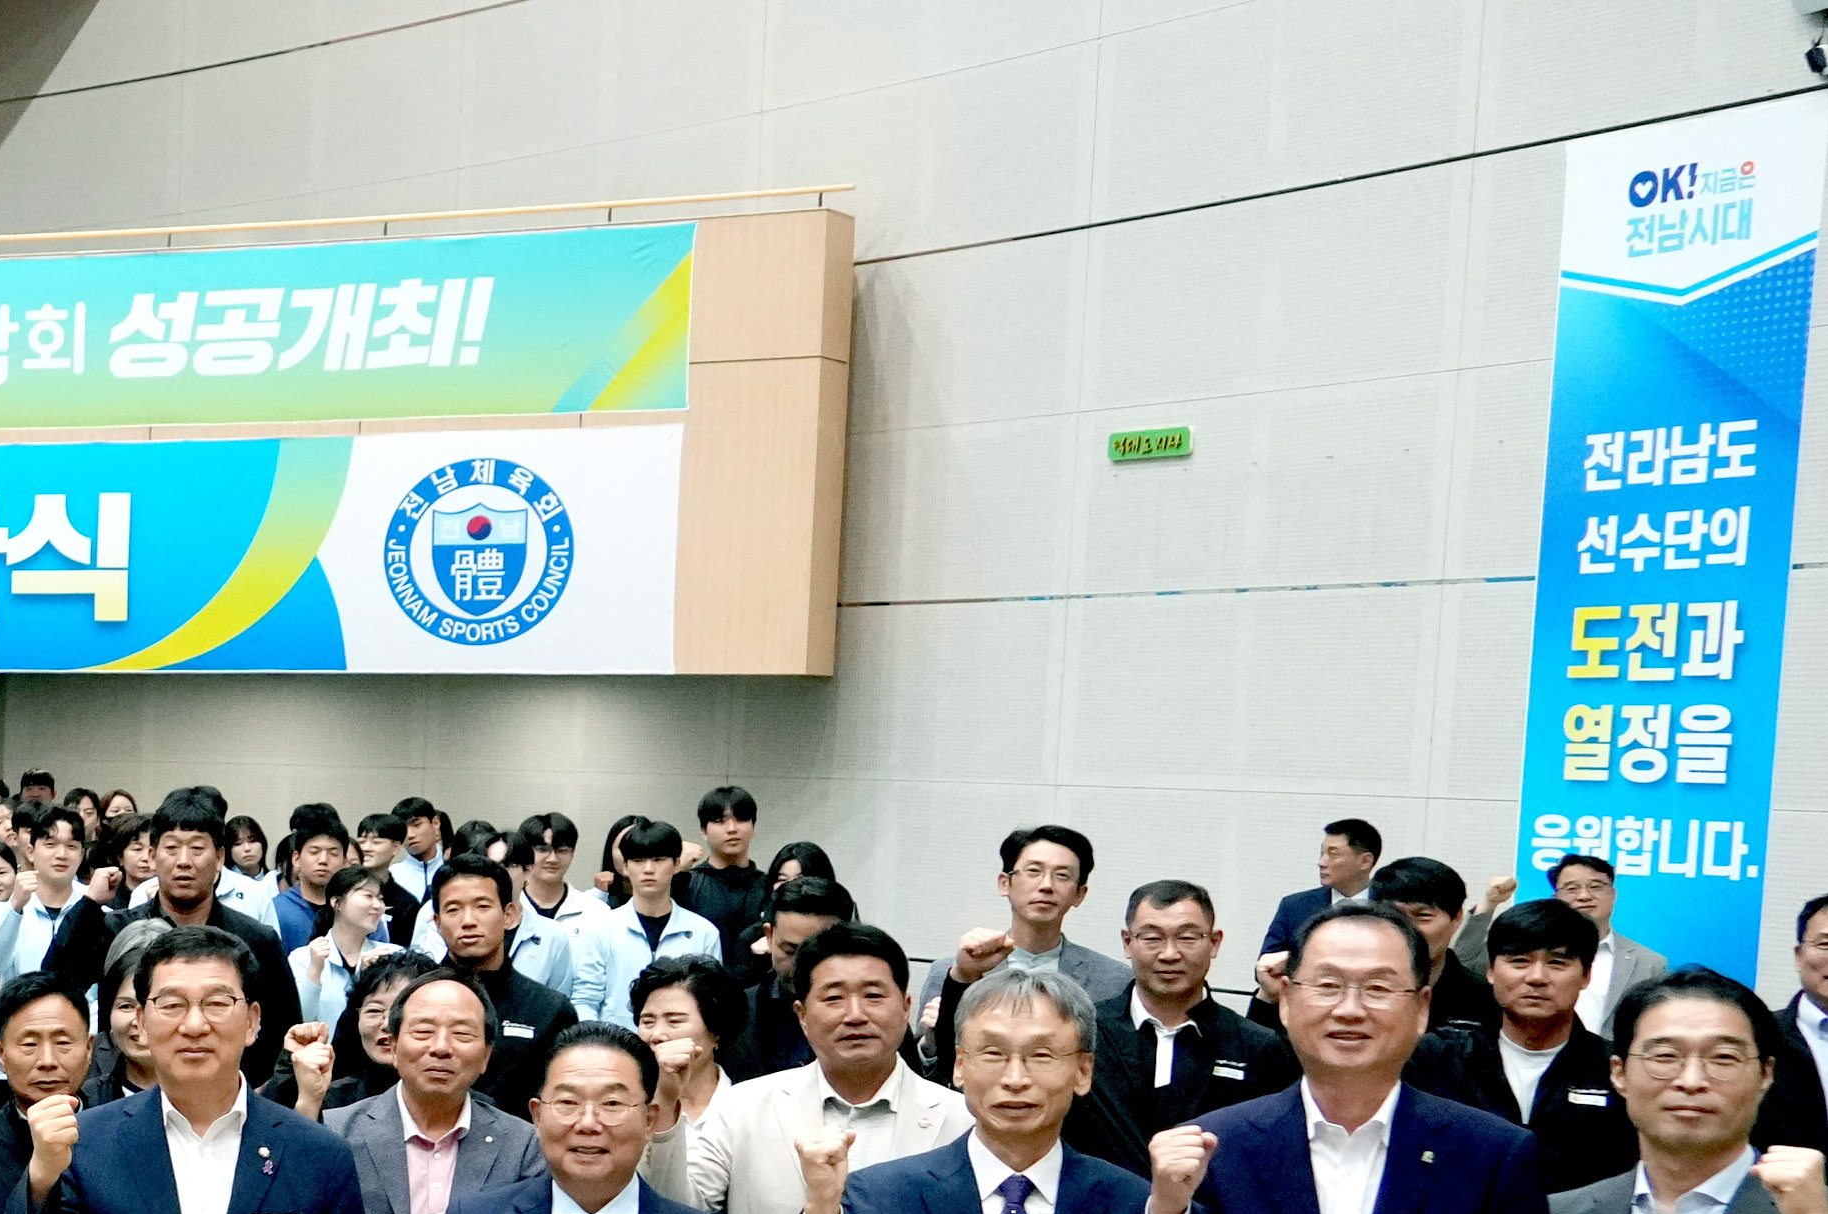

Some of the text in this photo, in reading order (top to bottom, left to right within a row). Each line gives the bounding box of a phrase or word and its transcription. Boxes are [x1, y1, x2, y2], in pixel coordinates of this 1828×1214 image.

[1628, 161, 1756, 208] OK! 지금은
[1626, 198, 1753, 258] 전남시대
[107, 276, 496, 380] 성공개최!
[1583, 419, 1758, 492] 전라남도
[1577, 505, 1752, 575] 선수단의
[387, 536, 570, 642] JEONNAM SPORTS COUNCIL
[1566, 600, 1745, 681] 도전과
[1563, 703, 1733, 785] 열정을
[1531, 813, 1759, 881] 응원합니다.
